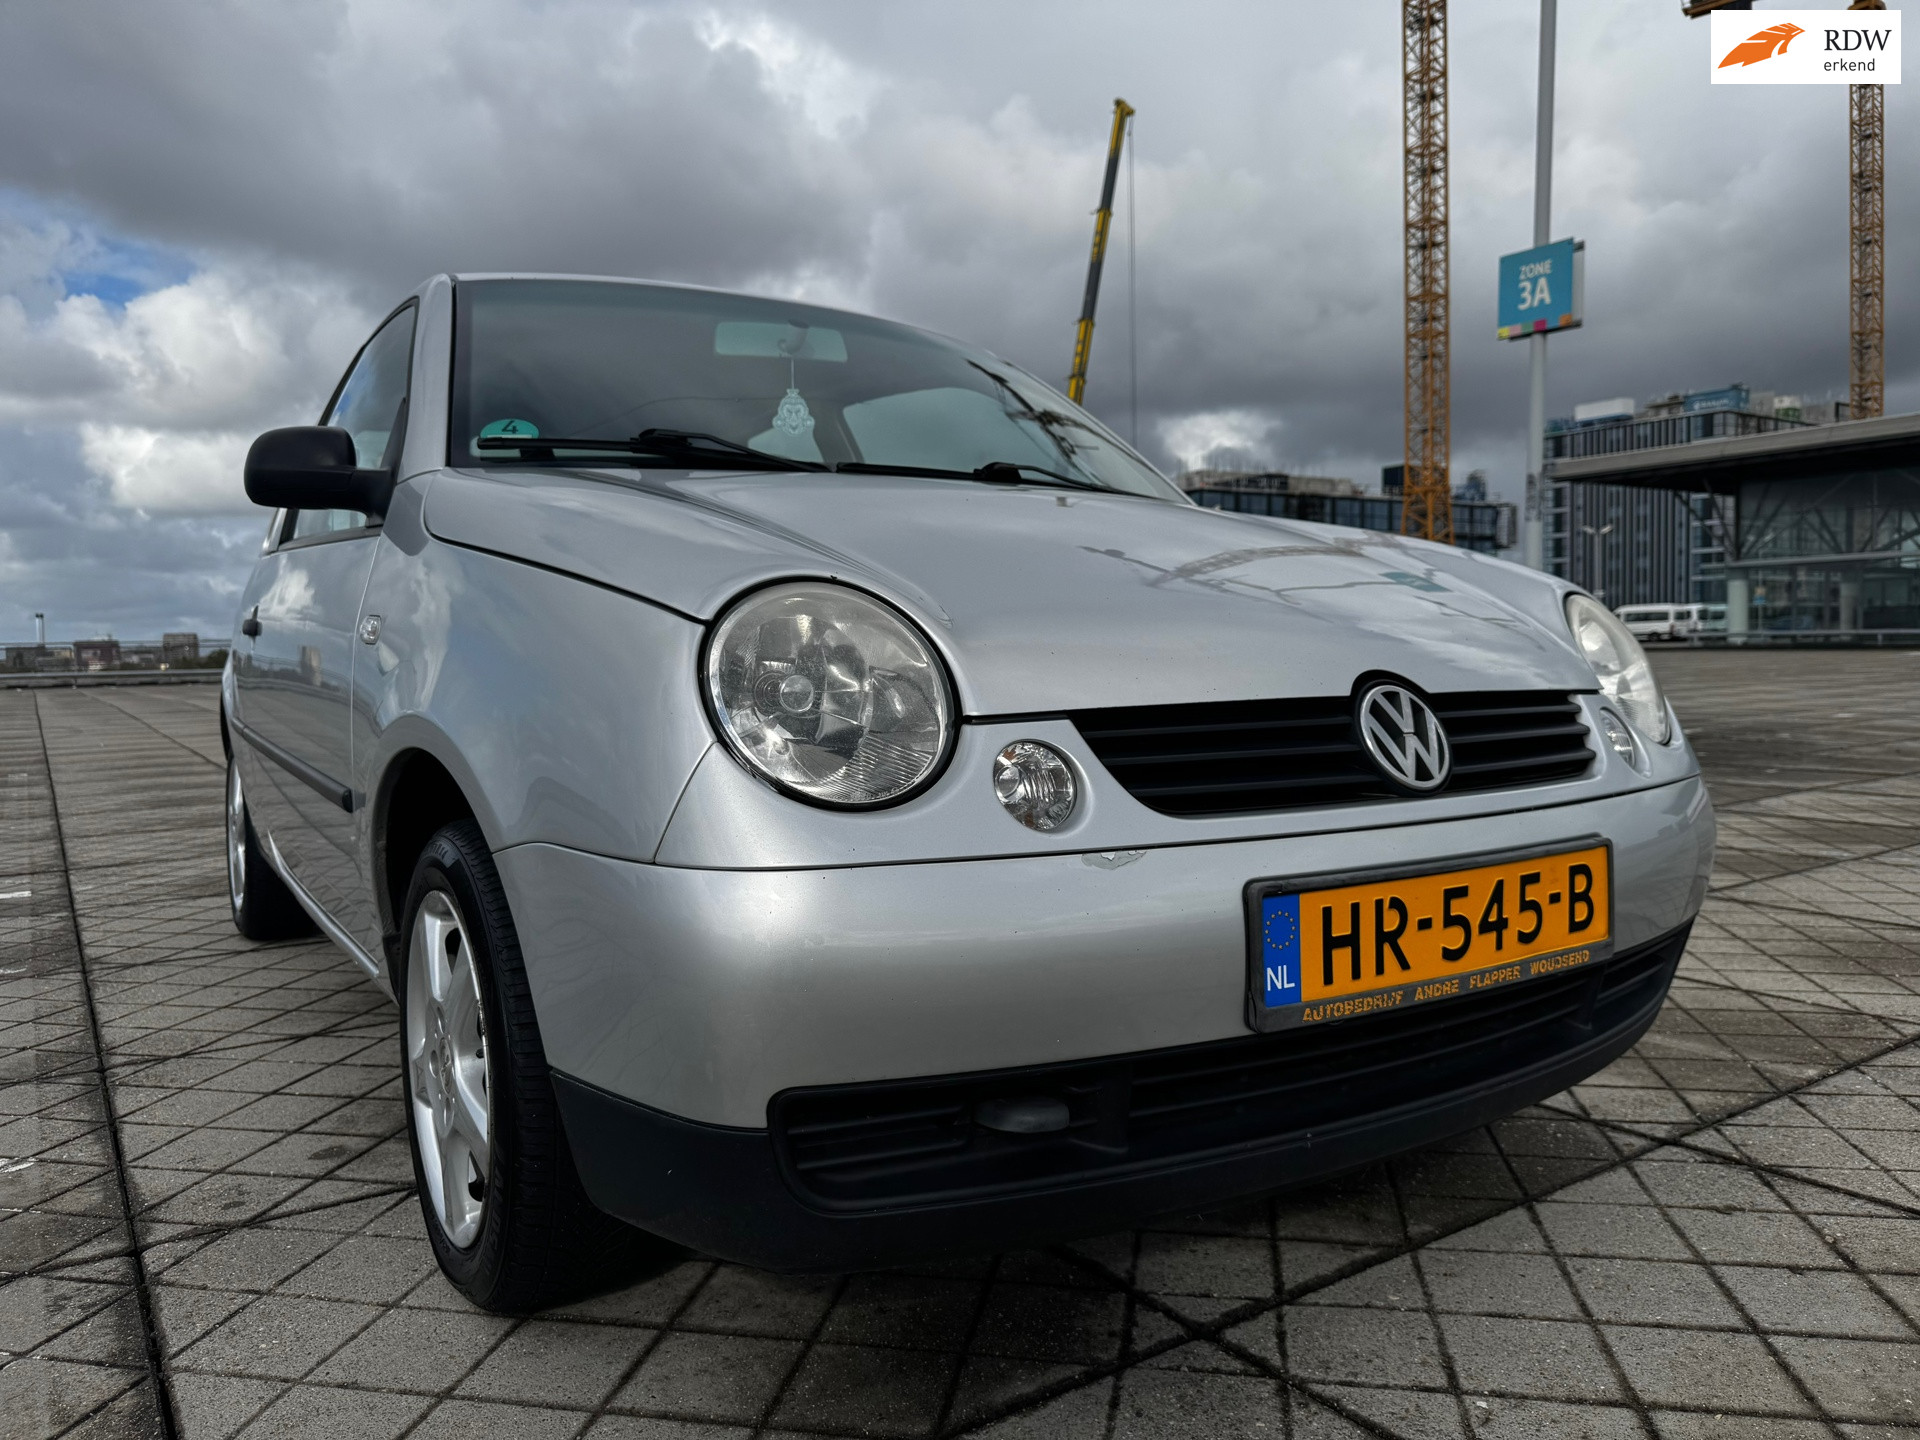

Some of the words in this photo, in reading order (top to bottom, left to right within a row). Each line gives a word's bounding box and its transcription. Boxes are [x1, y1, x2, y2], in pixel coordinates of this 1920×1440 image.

[1519, 259, 1551, 279] ZONE
[1517, 277, 1551, 310] 3A
[501, 420, 518, 434] 4
[1320, 863, 1595, 987] HR-545-B
[1266, 965, 1295, 992] NL
[1301, 990, 1404, 1022] AUTOBEDRIJF
[1414, 980, 1460, 1001] ANDRE
[1469, 965, 1521, 989] FLAPPER
[1529, 949, 1591, 975] WOUDSEND
